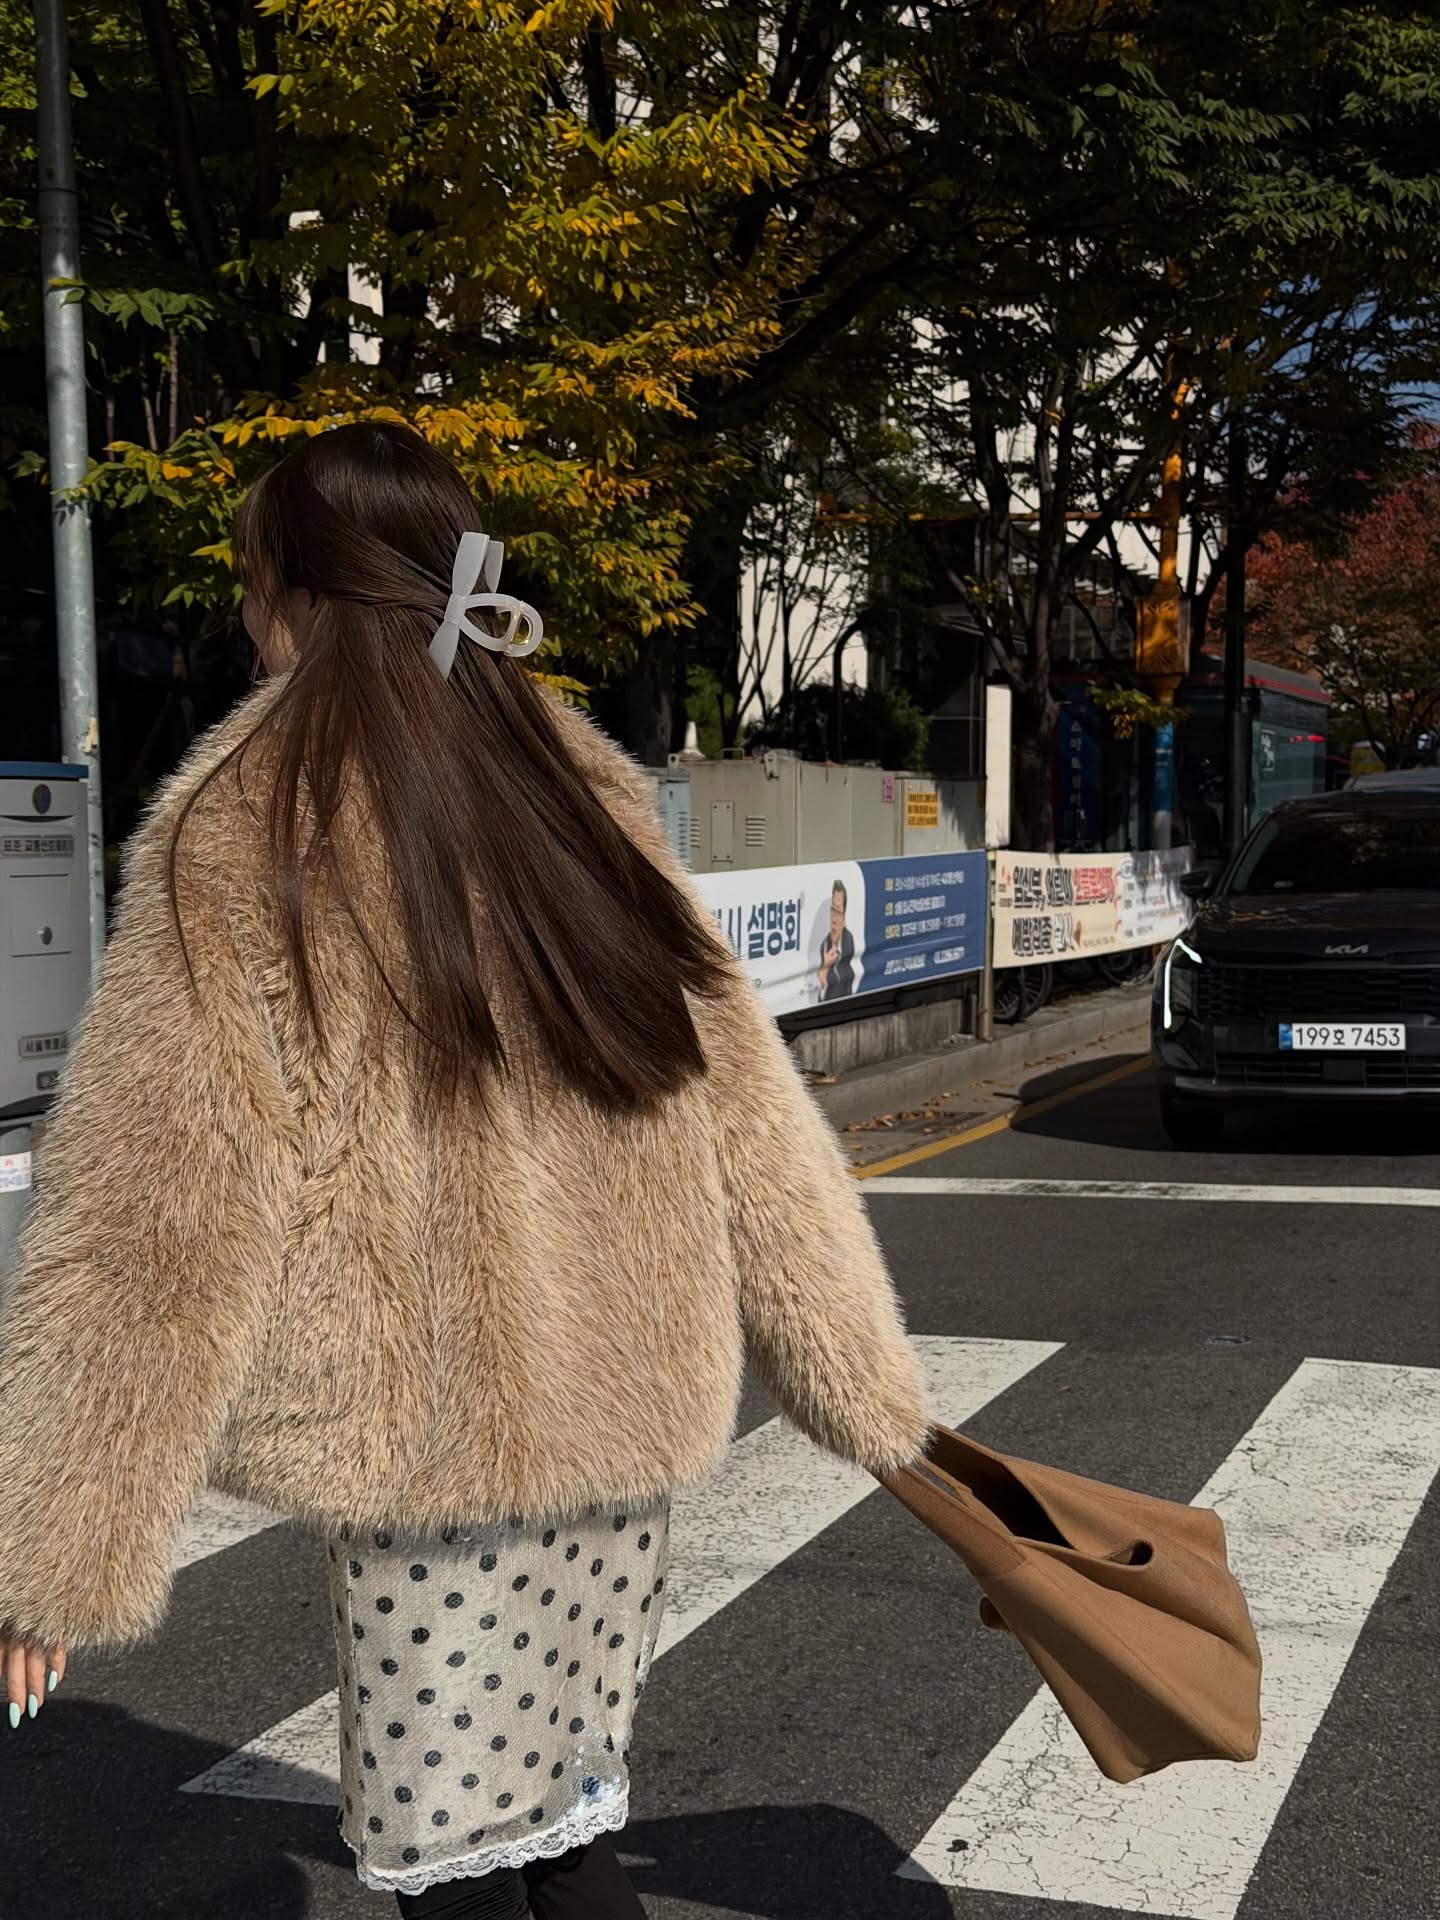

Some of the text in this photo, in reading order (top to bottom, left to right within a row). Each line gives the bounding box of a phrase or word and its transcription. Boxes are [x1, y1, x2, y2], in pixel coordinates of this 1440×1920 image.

[747, 898, 801, 960] 설명회
[1012, 915, 1054, 957] 예방접종
[1324, 943, 1369, 954] KIA
[1296, 1026, 1345, 1046] 199호
[1351, 1026, 1401, 1047] 7453
